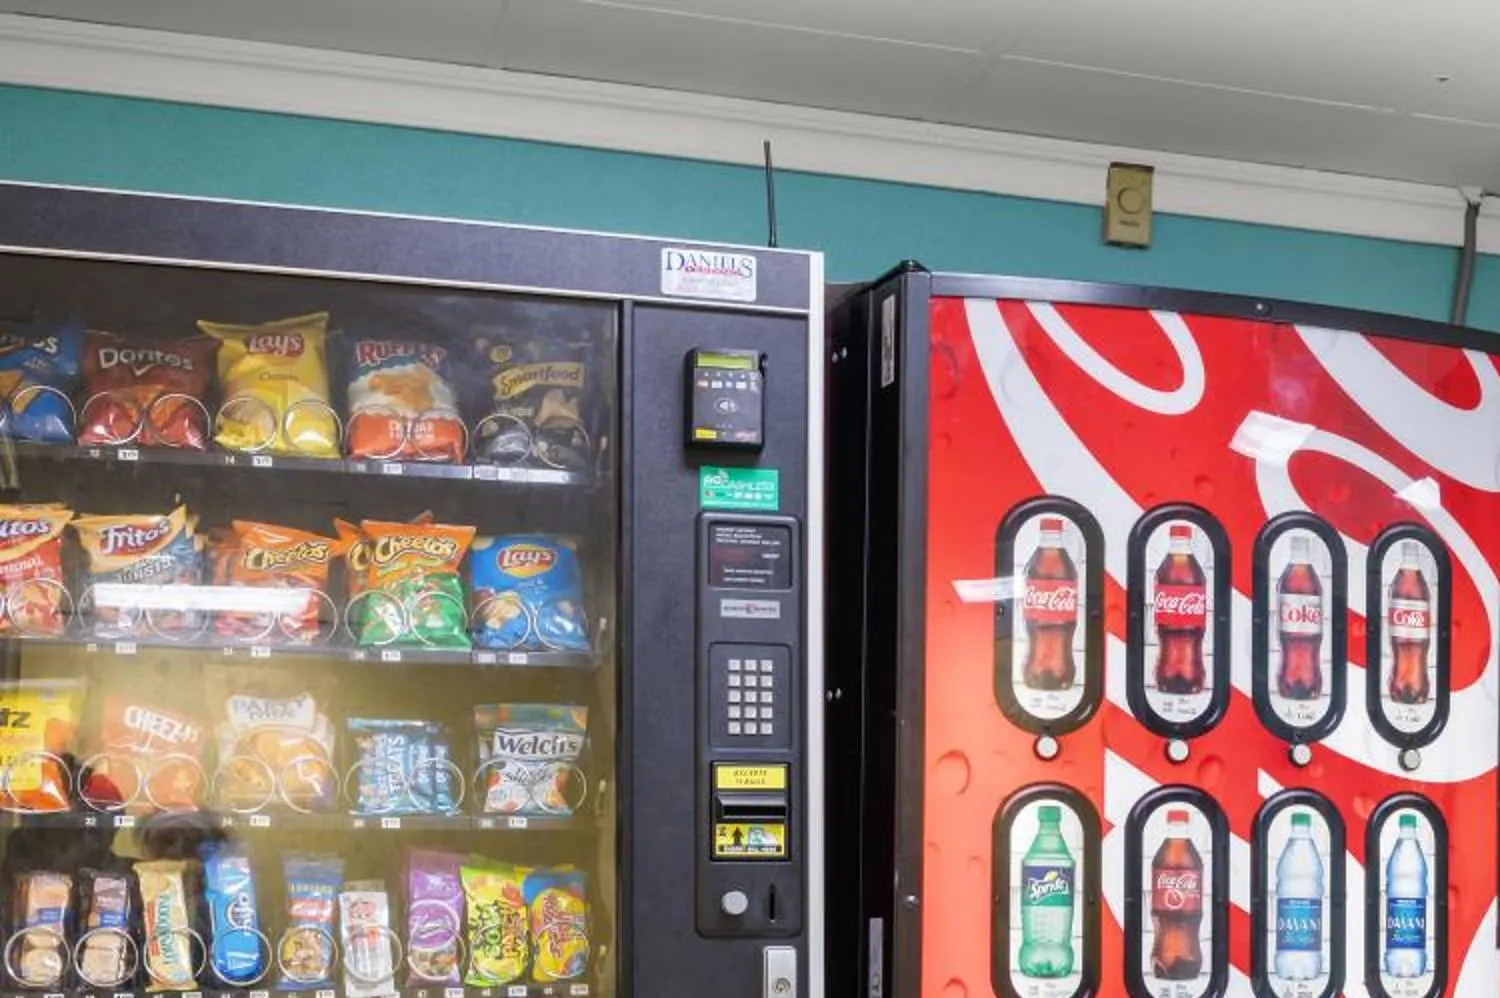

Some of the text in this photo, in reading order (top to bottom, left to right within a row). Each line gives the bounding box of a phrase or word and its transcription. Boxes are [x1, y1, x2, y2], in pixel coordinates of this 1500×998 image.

[98, 348, 195, 371] Doritos
[500, 368, 582, 397] Smartfood
[100, 517, 171, 551] Fritos
[246, 543, 329, 571] Cheetos
[374, 533, 459, 565] Cheetos
[1279, 602, 1322, 625] Coke
[1392, 607, 1426, 626] Coke
[1029, 878, 1068, 901] Sprite
